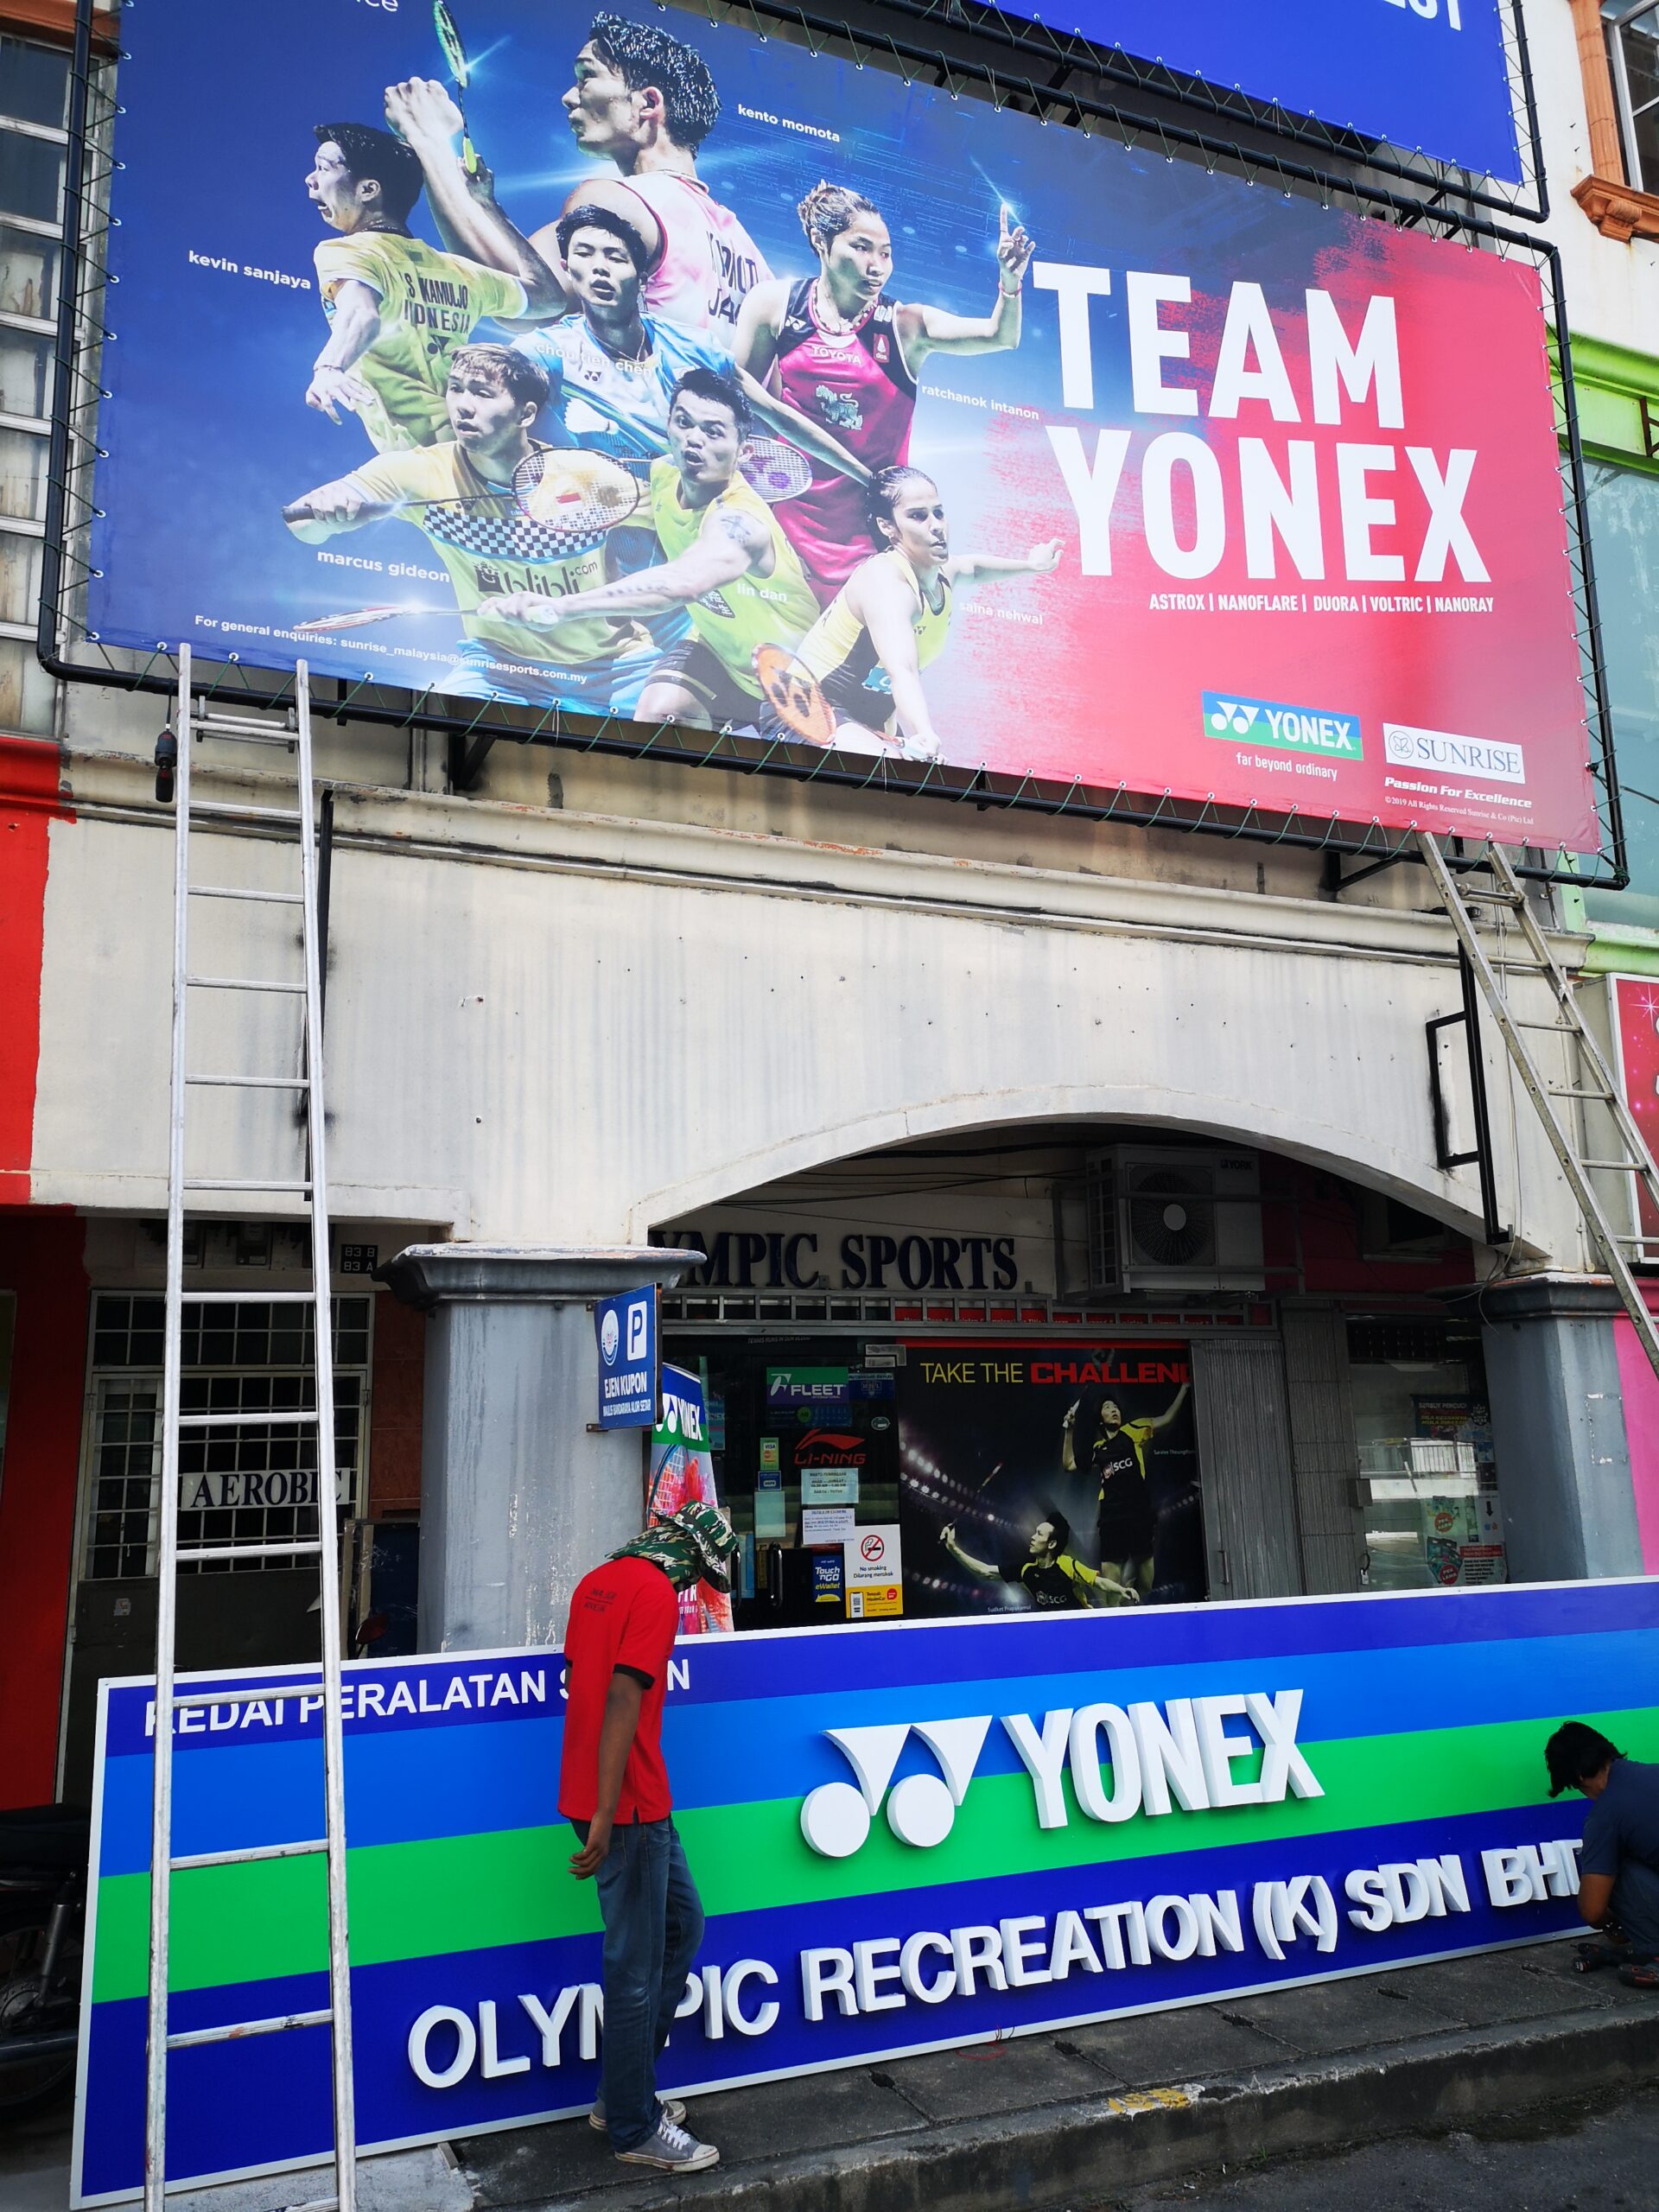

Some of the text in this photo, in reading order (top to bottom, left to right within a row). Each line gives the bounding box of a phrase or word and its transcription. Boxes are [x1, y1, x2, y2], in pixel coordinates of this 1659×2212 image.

[738, 104, 841, 143] kento momota
[188, 250, 311, 289] kevin sanjaya
[537, 344, 576, 359] chou
[615, 359, 653, 377] chen
[812, 346, 861, 364] TOYOTA
[1033, 261, 1405, 429] TEAM
[921, 385, 1039, 420] ratchanok intanon
[1045, 425, 1492, 582] YONEX
[317, 550, 450, 582] marcus gideon
[737, 583, 788, 602] lin dan
[1149, 594, 1494, 613] ASTROX NANOFLARE DUORA VOLTRIC NANORAY
[194, 614, 218, 628] For
[221, 620, 270, 636] general
[273, 628, 337, 646] enquiries:
[997, 608, 1044, 625] nehwal
[1264, 709, 1353, 751] YONEX
[1236, 752, 1338, 782] far beyond ordinary
[1416, 737, 1521, 774] SUNRISE
[1384, 777, 1532, 809] Passion For Excellence
[1419, 801, 1439, 811] Rights
[1440, 804, 1467, 816] Reserved
[1467, 809, 1490, 819] Sunrise
[345, 1262, 374, 1271] 83 A
[648, 1230, 1018, 1291] MPIC SPORTS
[632, 1309, 643, 1353] P
[604, 1372, 647, 1399] EJEN KUPON
[920, 1363, 976, 1383] TAKE
[980, 1363, 1024, 1383] THE
[791, 1384, 844, 1396] FLEET
[794, 1452, 867, 1465] LI-NING
[1113, 1458, 1133, 1471] SCG
[815, 1566, 841, 1574] Touch
[1000, 1688, 1325, 1829] YONEX
[800, 1889, 1244, 2022] RECREATION
[1251, 1874, 1338, 1961] (K)
[1344, 1853, 1471, 1933] SDN
